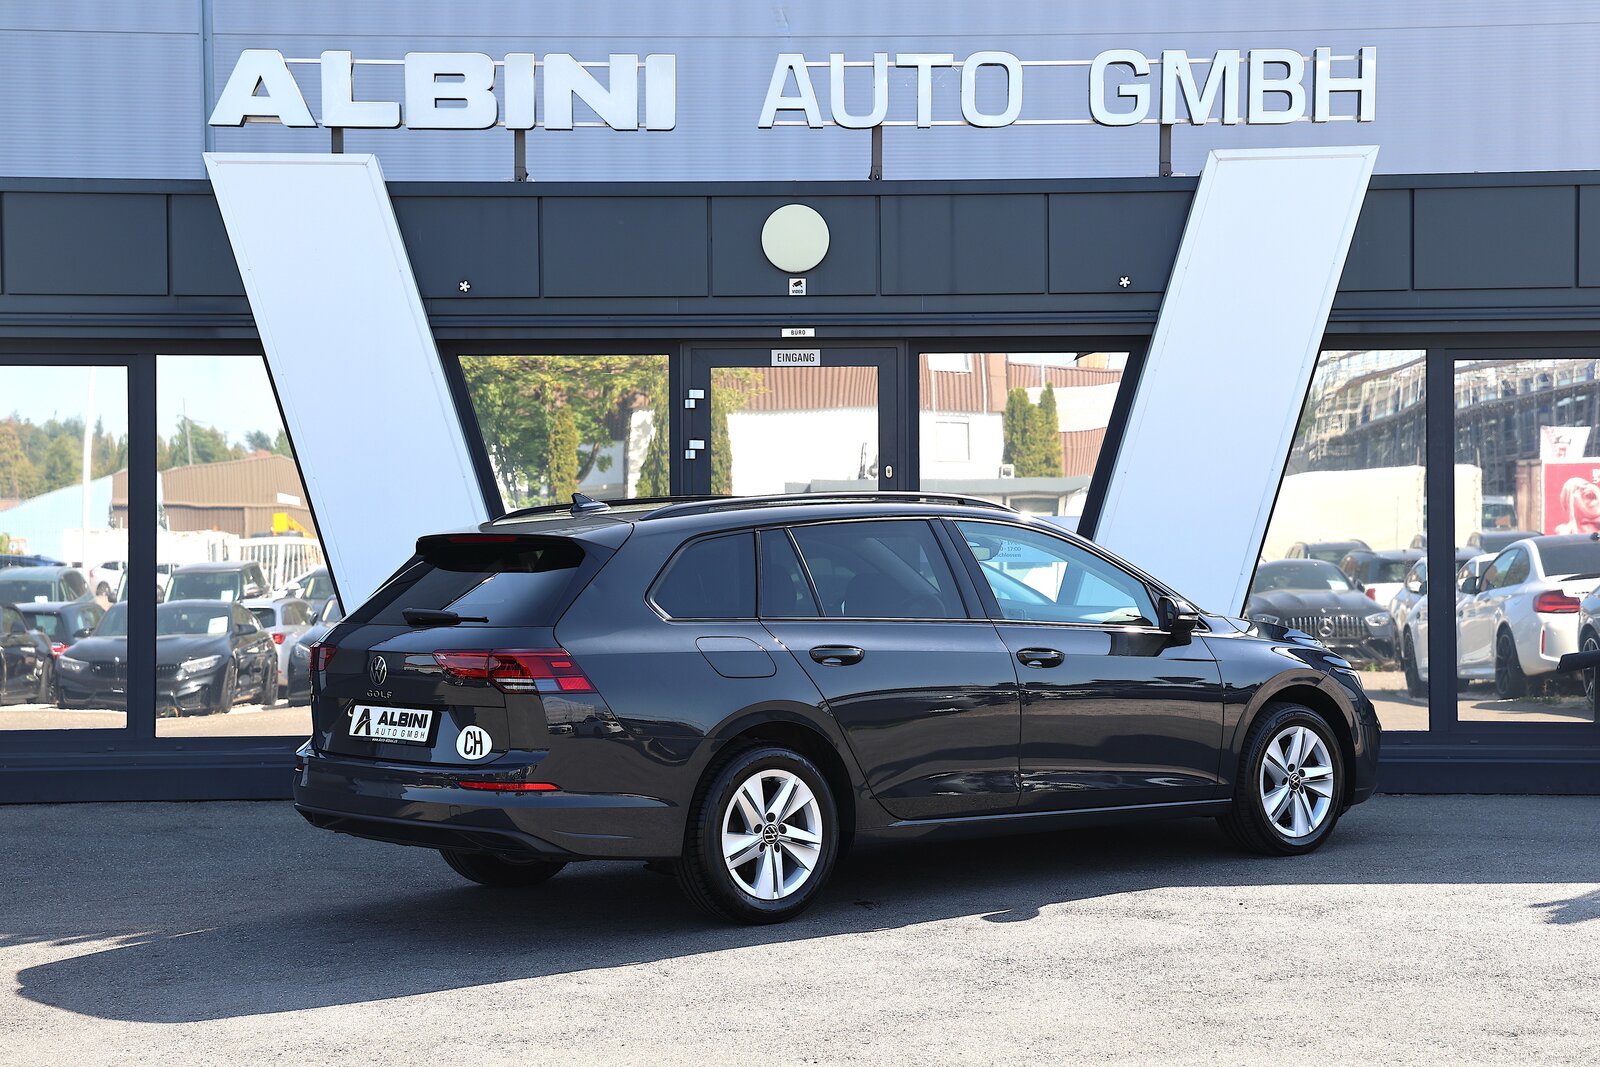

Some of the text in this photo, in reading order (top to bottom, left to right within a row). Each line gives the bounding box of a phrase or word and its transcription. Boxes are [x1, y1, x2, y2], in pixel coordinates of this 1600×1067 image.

[208, 46, 1377, 131] ALBINI AUTO GMBH
[777, 352, 815, 363] EINGANG
[366, 689, 393, 699] GOLF
[377, 710, 429, 729] ALBINI
[375, 728, 426, 739] AUTO GMBH
[463, 730, 483, 756] CH
